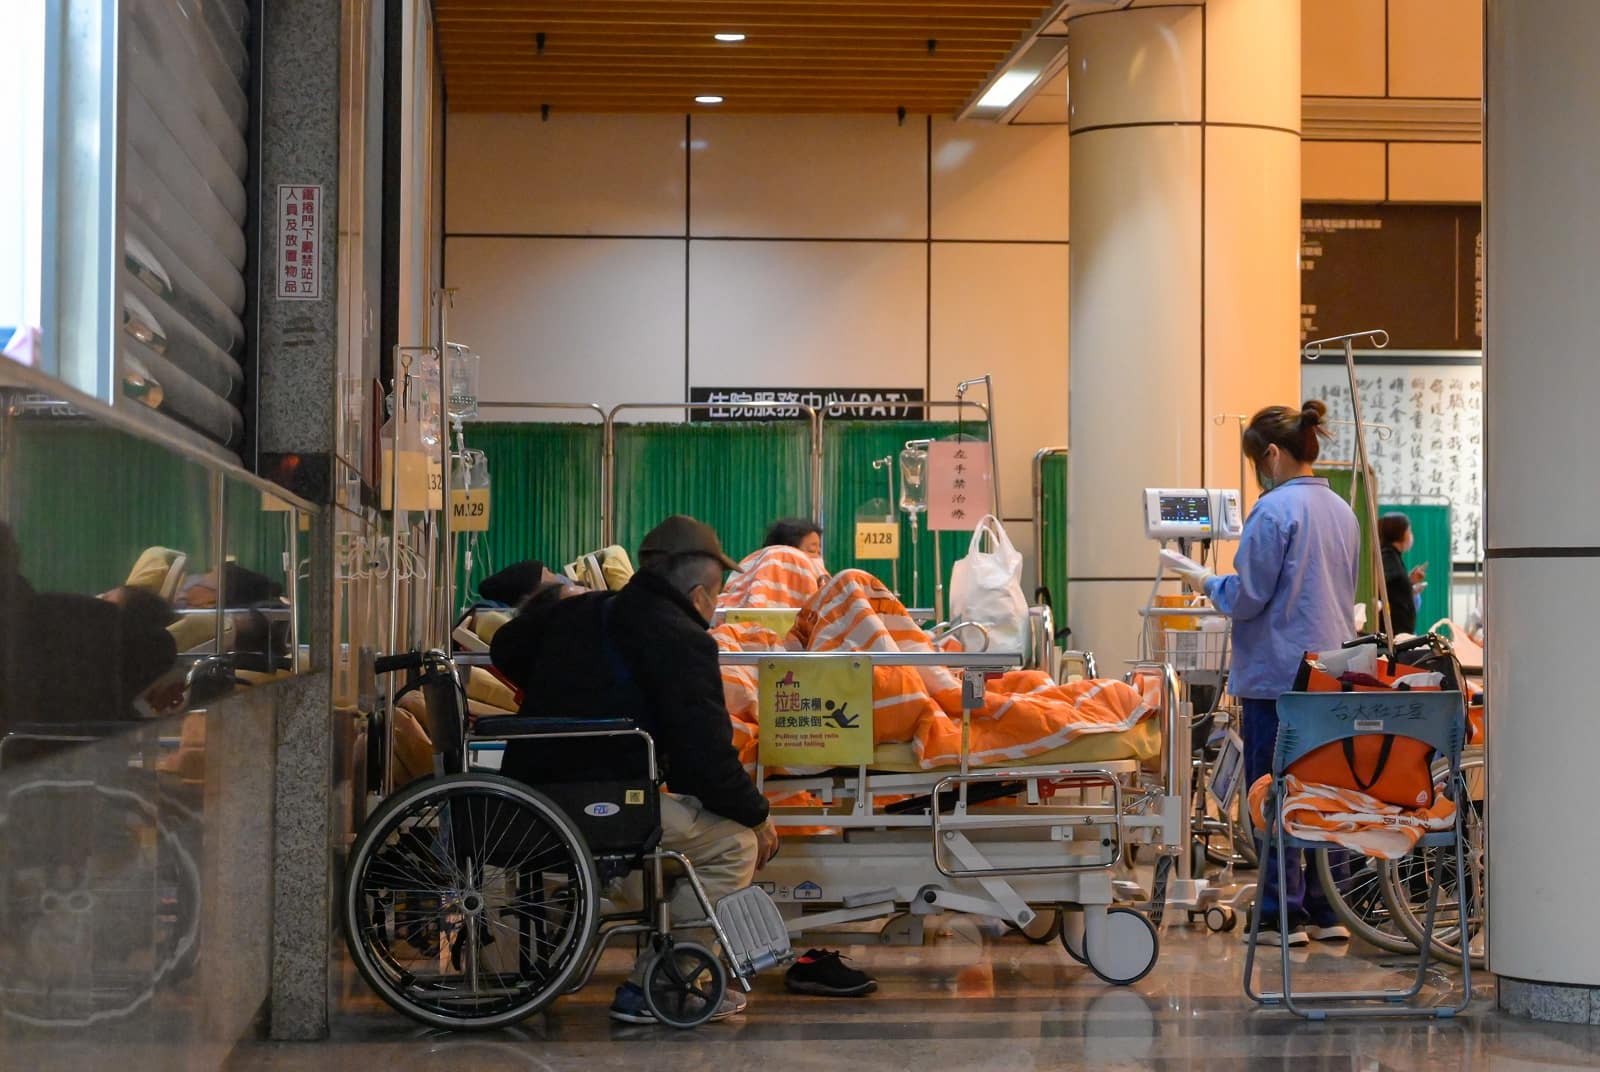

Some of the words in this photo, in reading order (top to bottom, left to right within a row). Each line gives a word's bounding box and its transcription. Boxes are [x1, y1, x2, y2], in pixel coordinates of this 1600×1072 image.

[285, 188, 298, 293] 人員及放置物品
[951, 449, 967, 520] 左手禁治療
[775, 690, 822, 713] 拉起床欄
[775, 716, 822, 728] 避免跌倒
